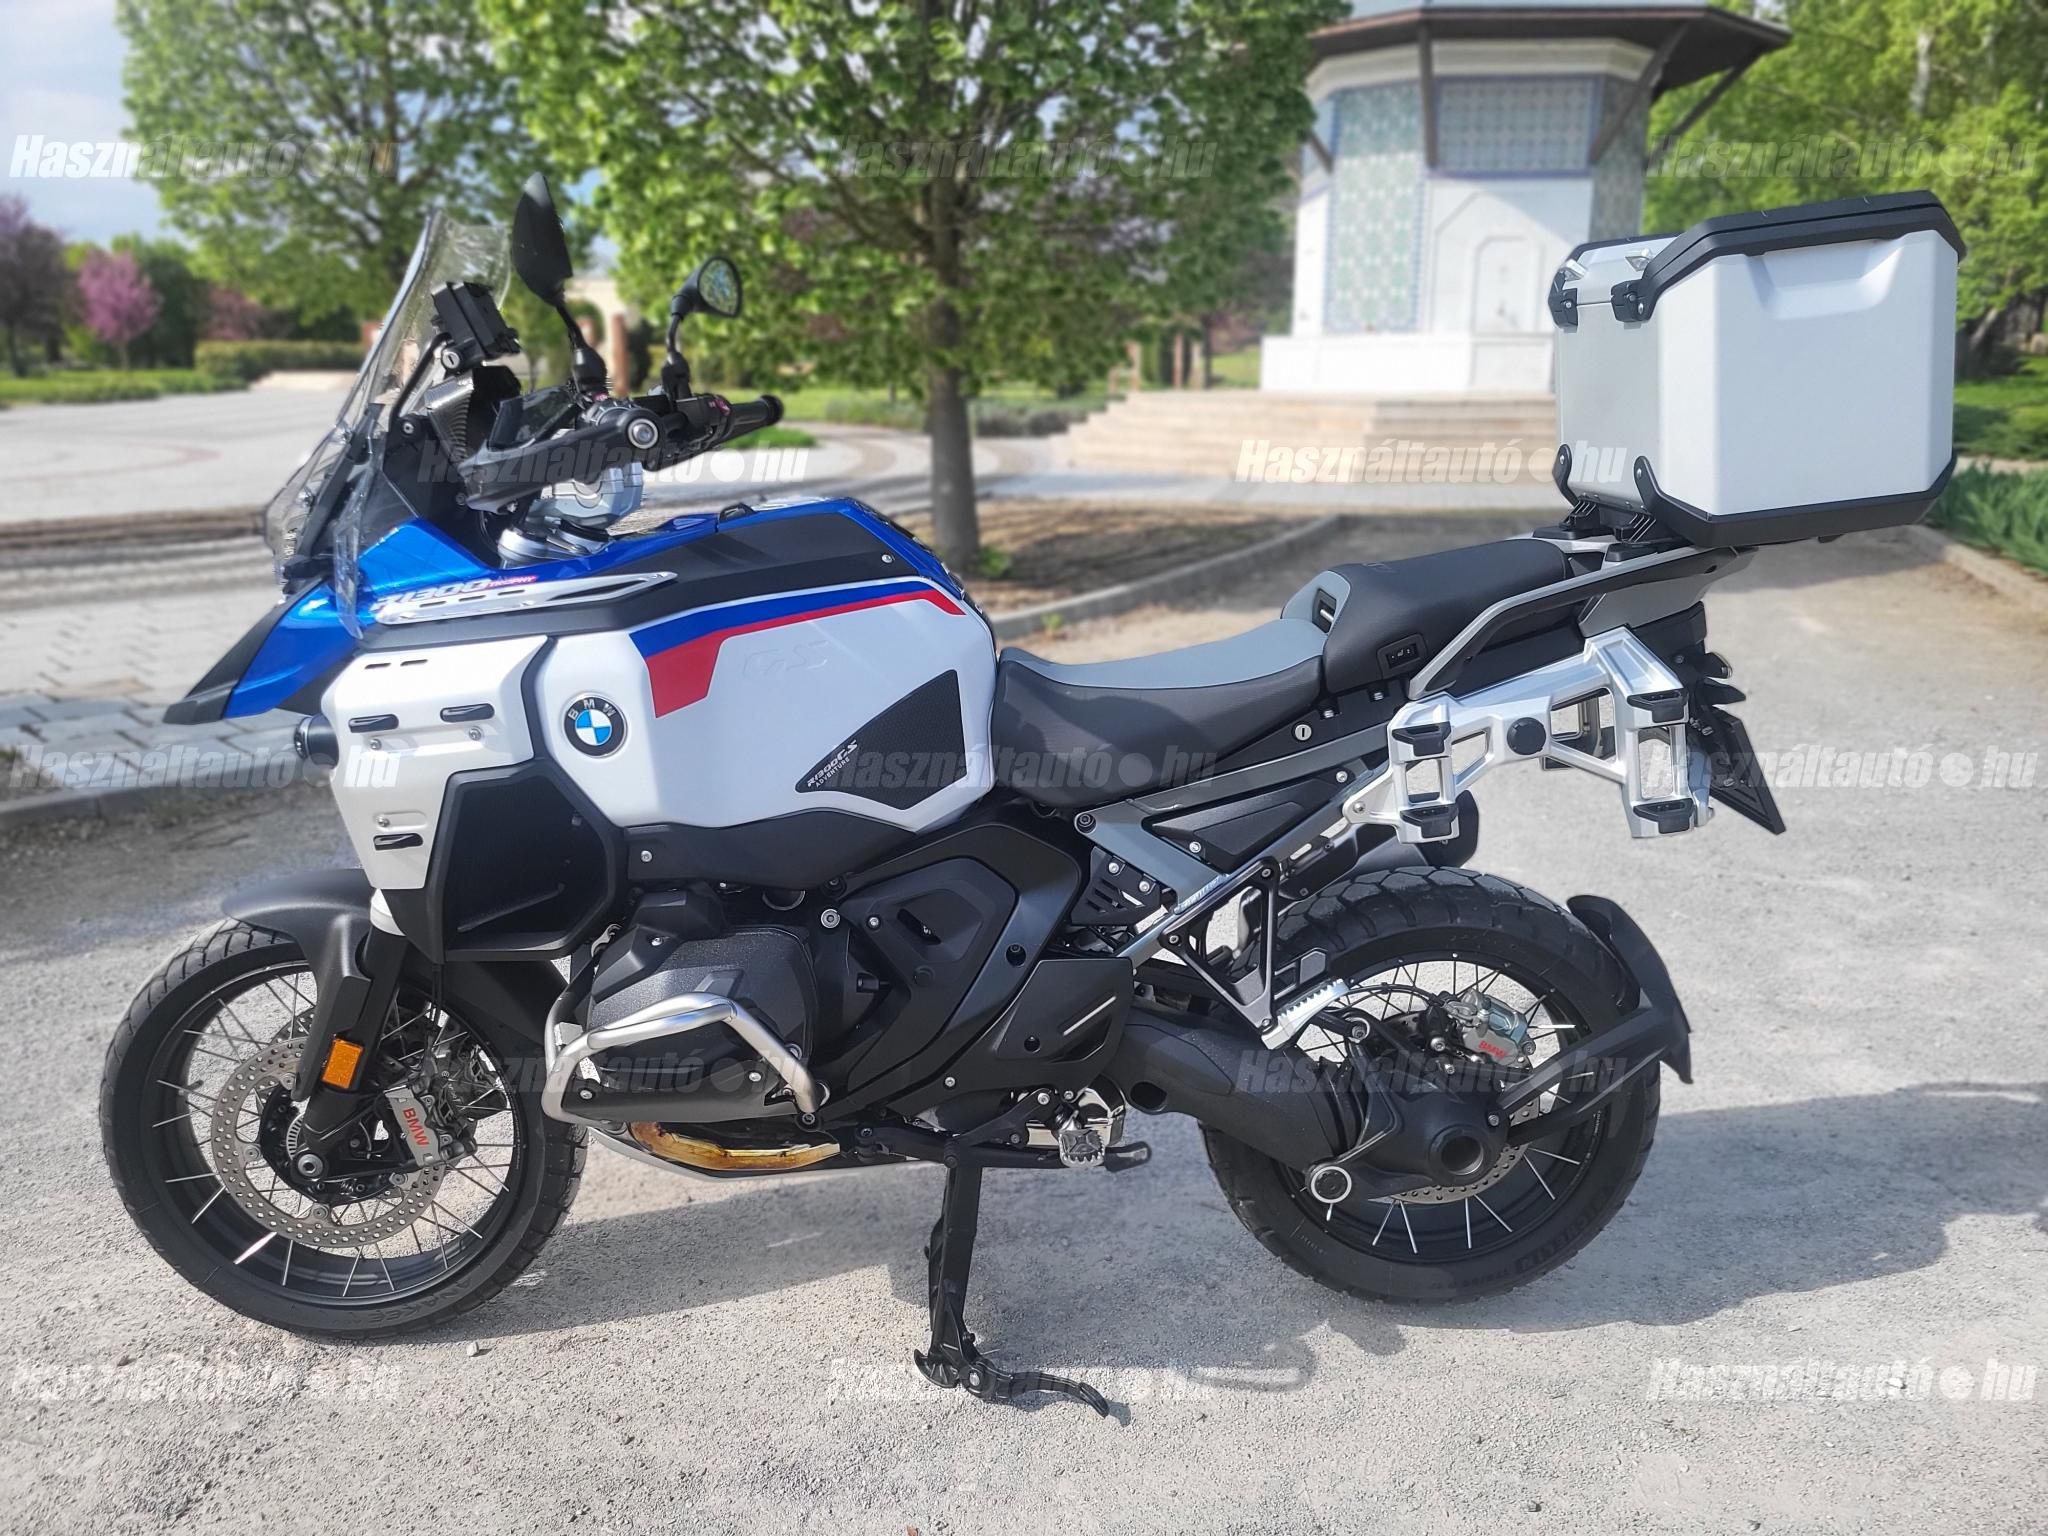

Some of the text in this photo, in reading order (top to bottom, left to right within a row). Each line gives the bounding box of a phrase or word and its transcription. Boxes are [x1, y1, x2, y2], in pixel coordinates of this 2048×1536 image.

[568, 699, 616, 721] BMW
[815, 757, 851, 788] ADVENTURE
[1478, 1040, 1508, 1060] BMW
[402, 1107, 430, 1146] BMW
